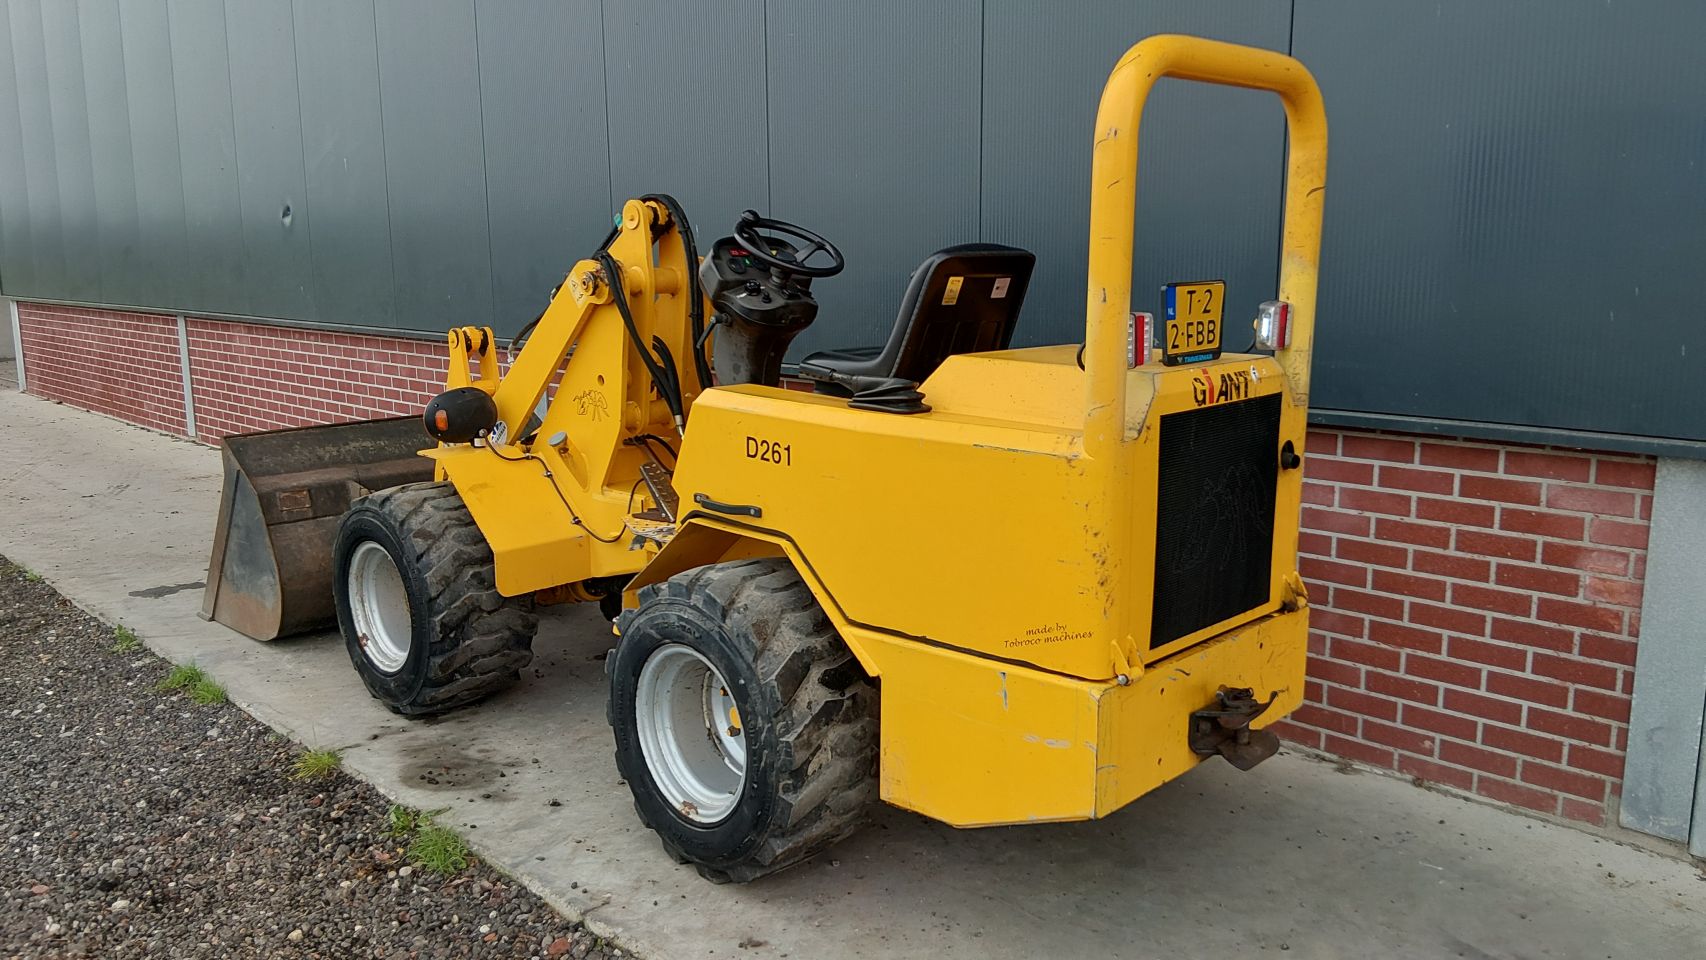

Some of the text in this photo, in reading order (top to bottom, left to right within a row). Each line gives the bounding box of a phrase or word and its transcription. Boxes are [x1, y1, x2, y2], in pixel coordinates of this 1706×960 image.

[746, 436, 791, 466] D261
[1026, 622, 1067, 636] made by
[1004, 631, 1093, 648] Tobroco machines
